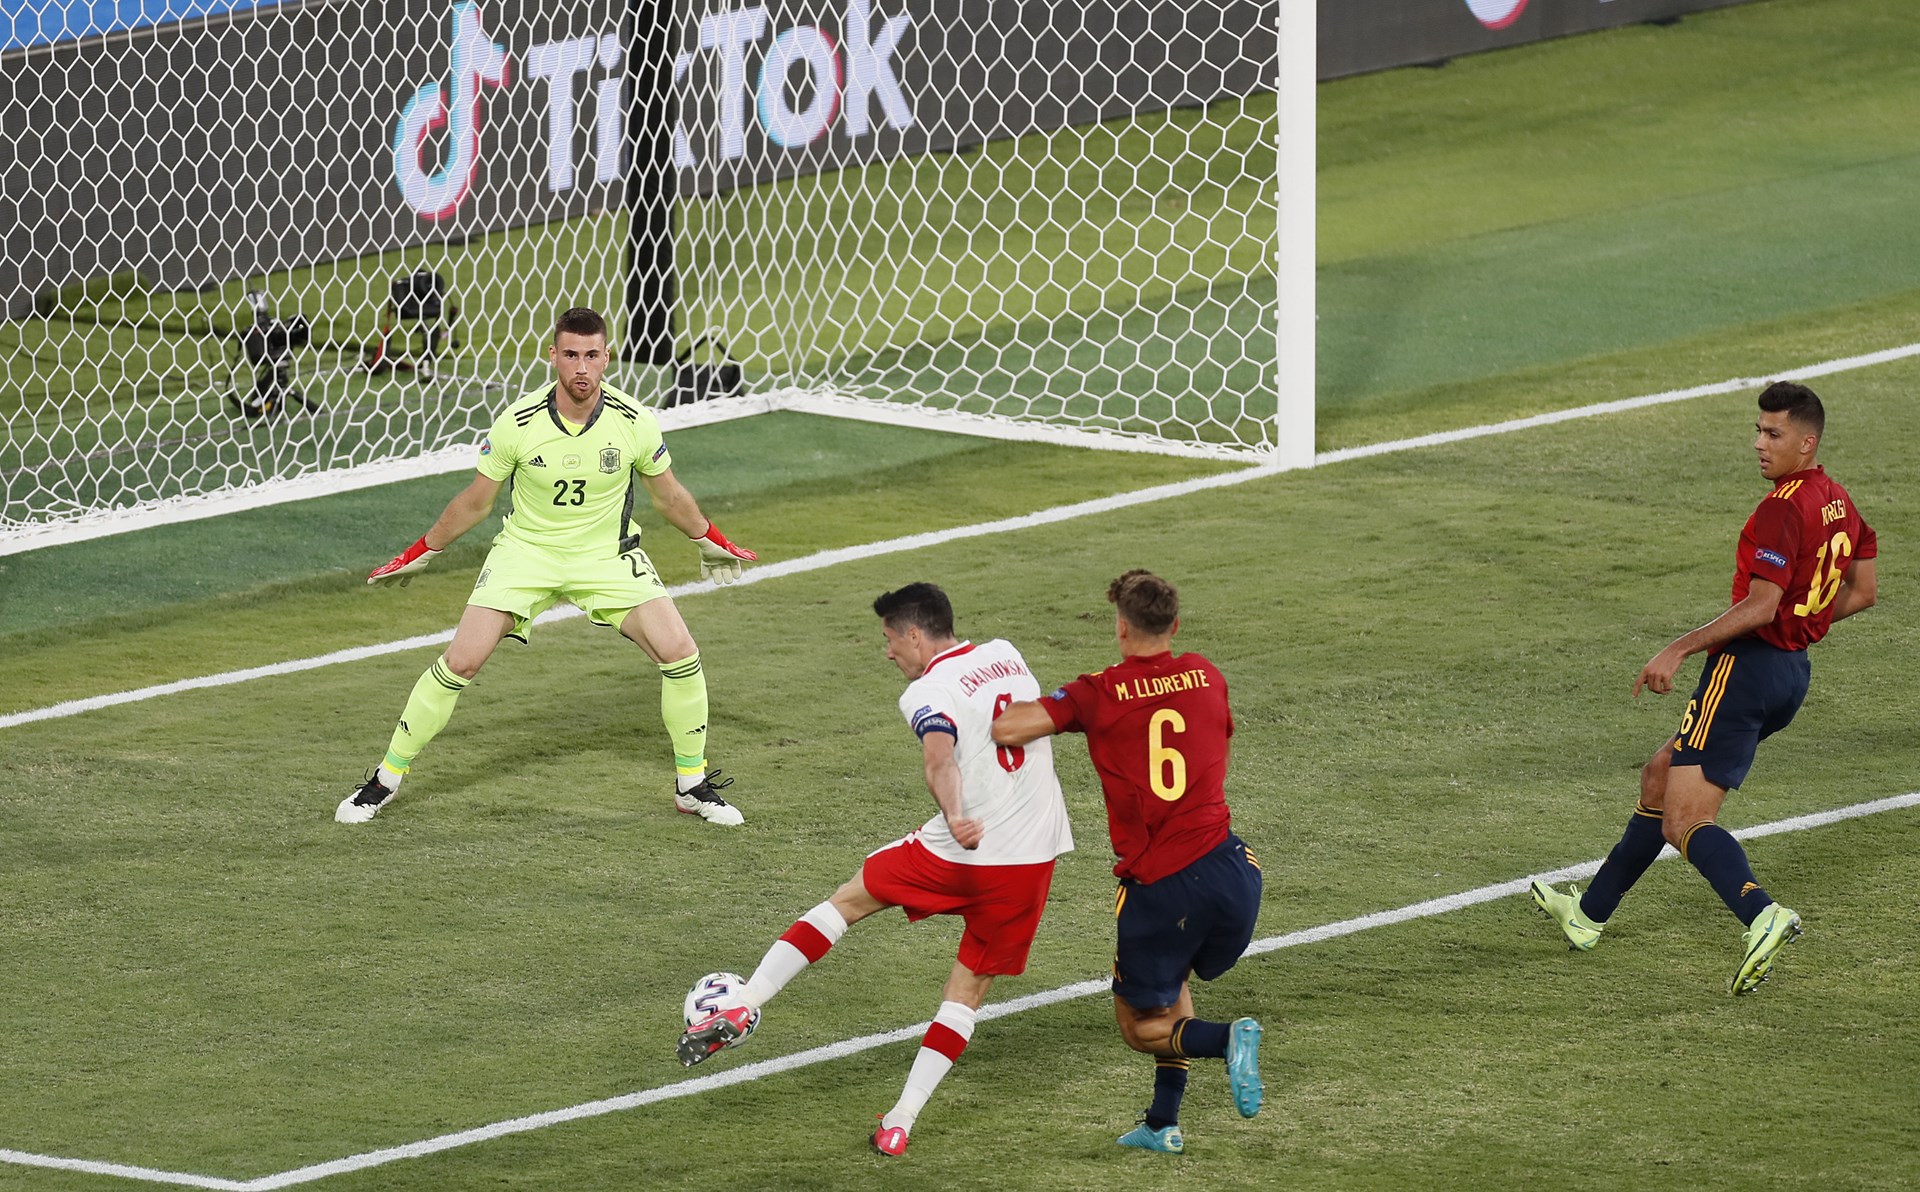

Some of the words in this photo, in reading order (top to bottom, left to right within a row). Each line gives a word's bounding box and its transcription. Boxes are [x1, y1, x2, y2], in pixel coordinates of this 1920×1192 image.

[526, 0, 915, 192] TiTok
[552, 479, 587, 506] 23
[620, 551, 656, 579] 23
[1793, 531, 1852, 617] 16
[958, 659, 1029, 698] LEWANOWSKI
[1114, 682, 1134, 701] M.
[1134, 674, 1210, 698] LLORENTE
[1681, 699, 1697, 735] 6
[1149, 708, 1187, 802] 6
